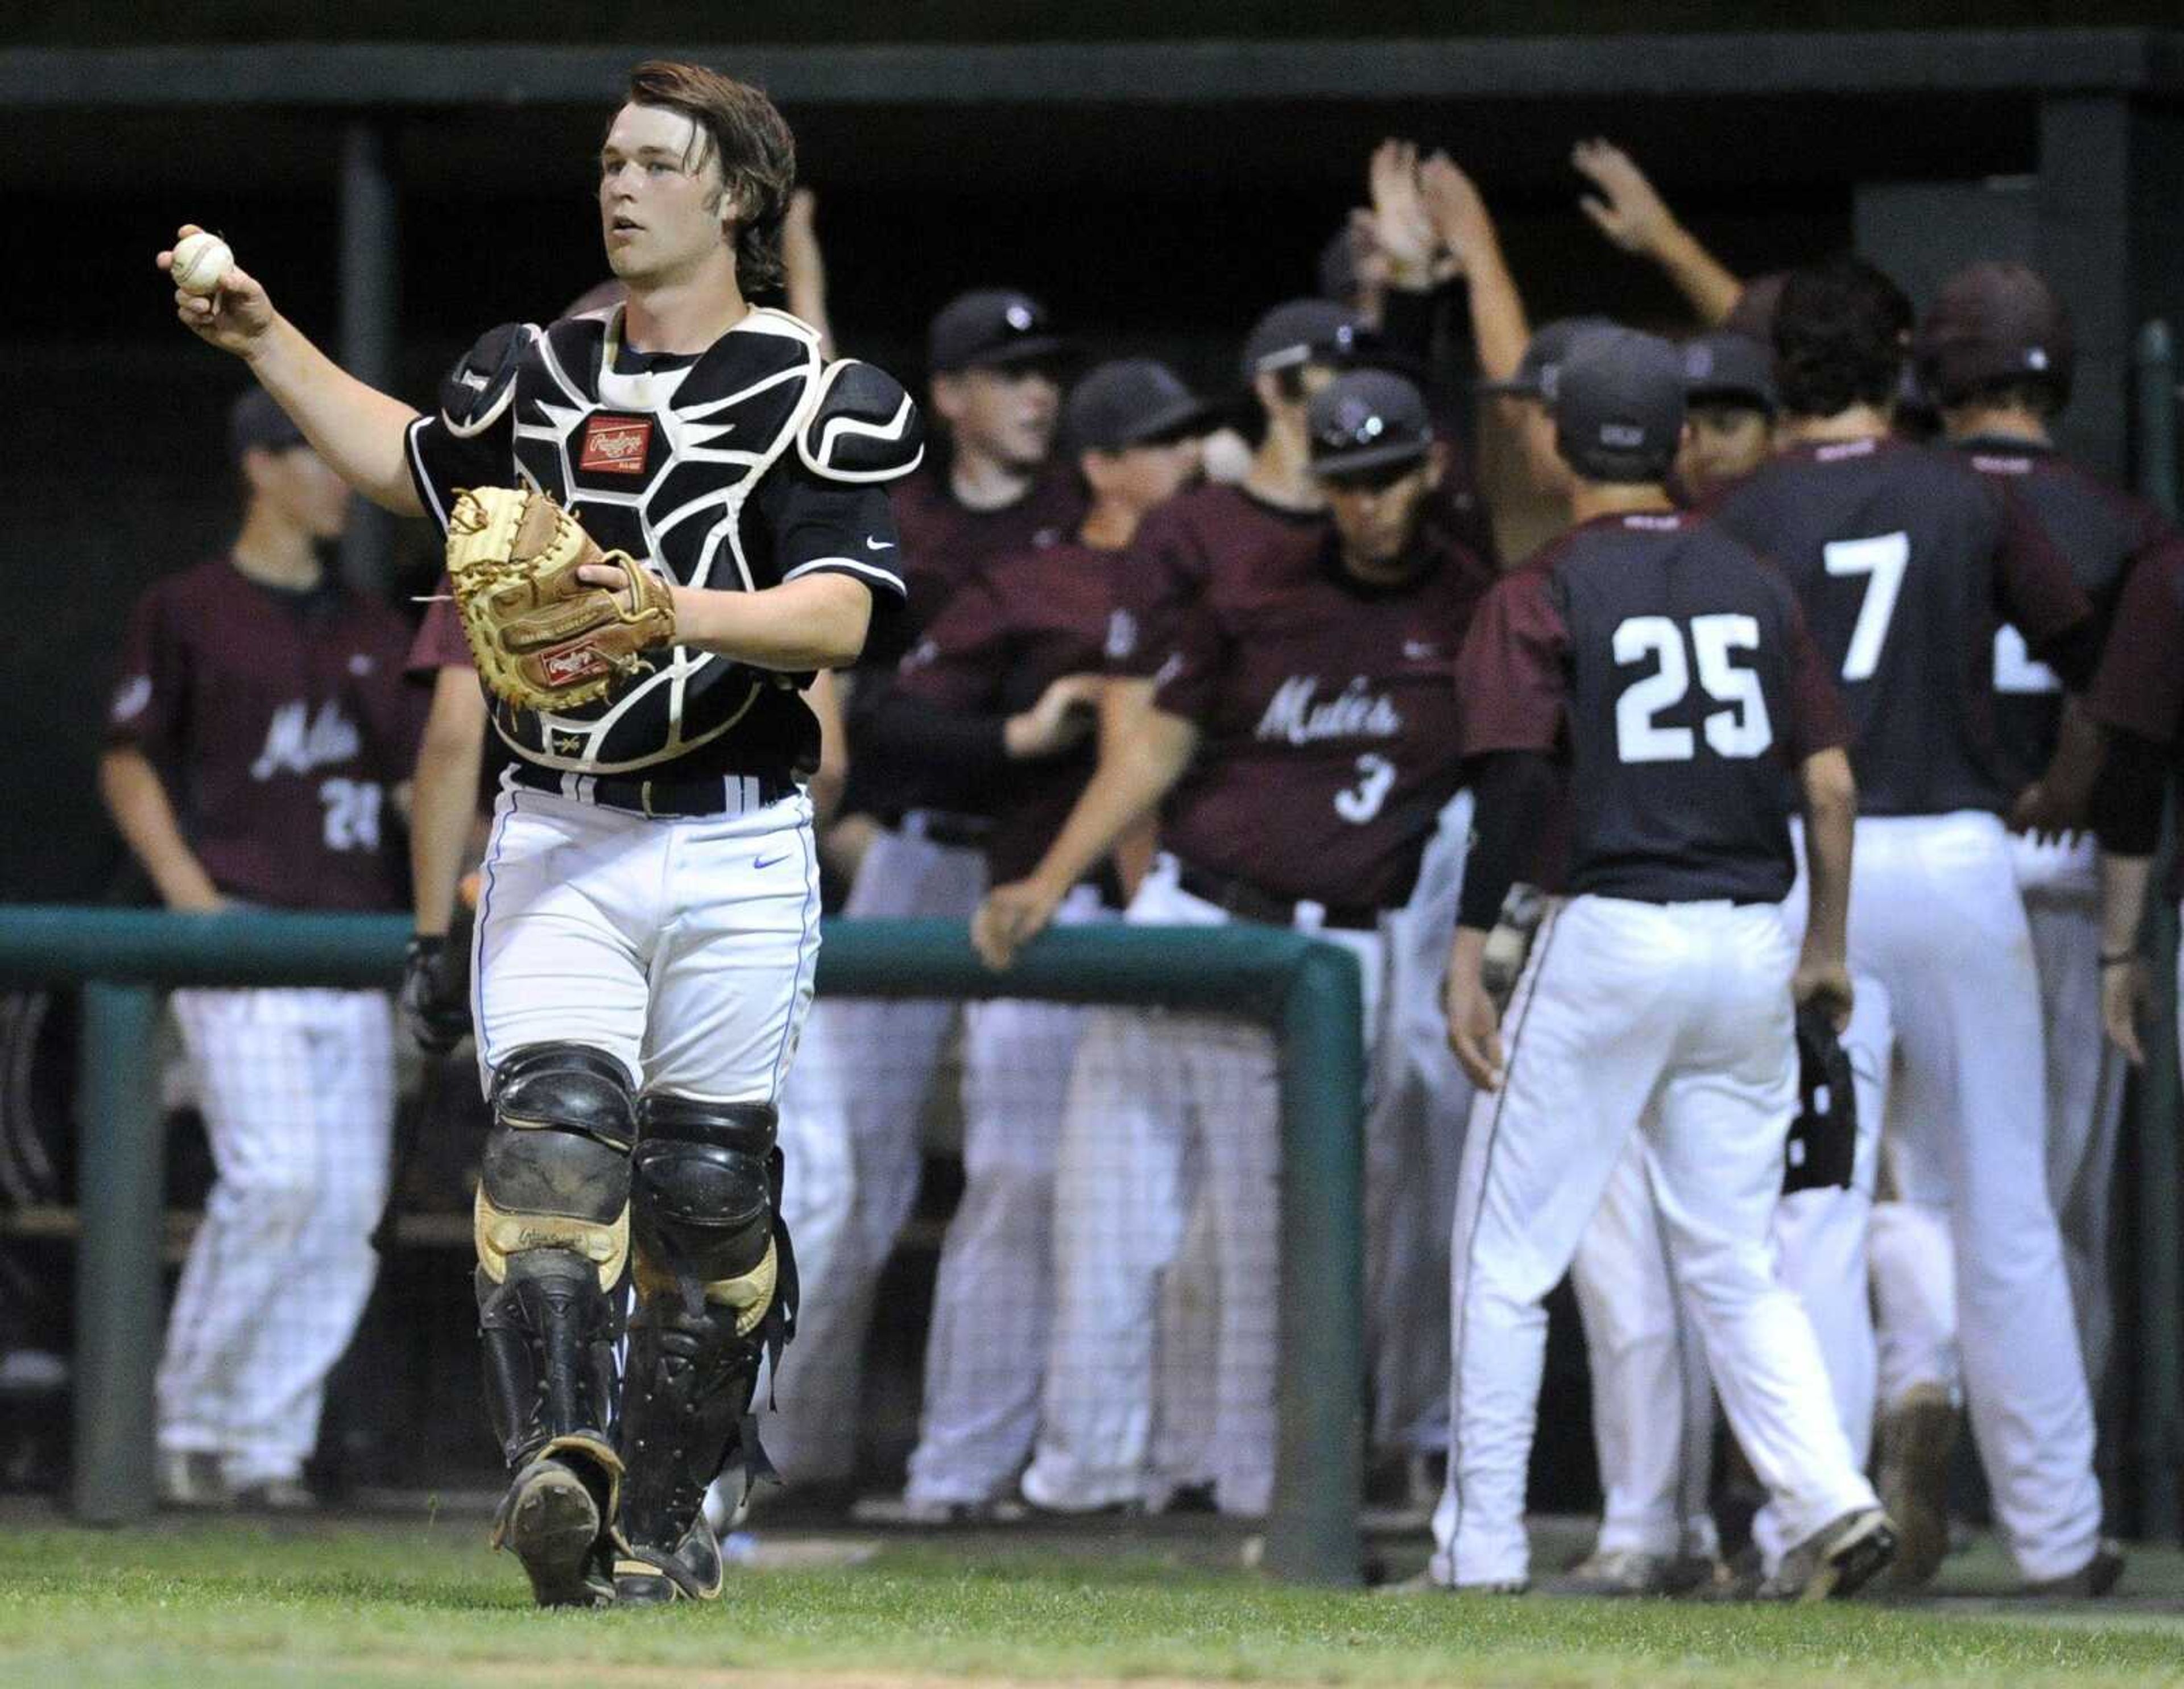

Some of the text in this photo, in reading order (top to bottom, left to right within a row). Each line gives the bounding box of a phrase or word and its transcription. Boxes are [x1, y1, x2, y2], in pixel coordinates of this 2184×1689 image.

[1823, 531, 1910, 681] 7
[1612, 614, 1773, 763] 25
[1334, 753, 1396, 822] 3
